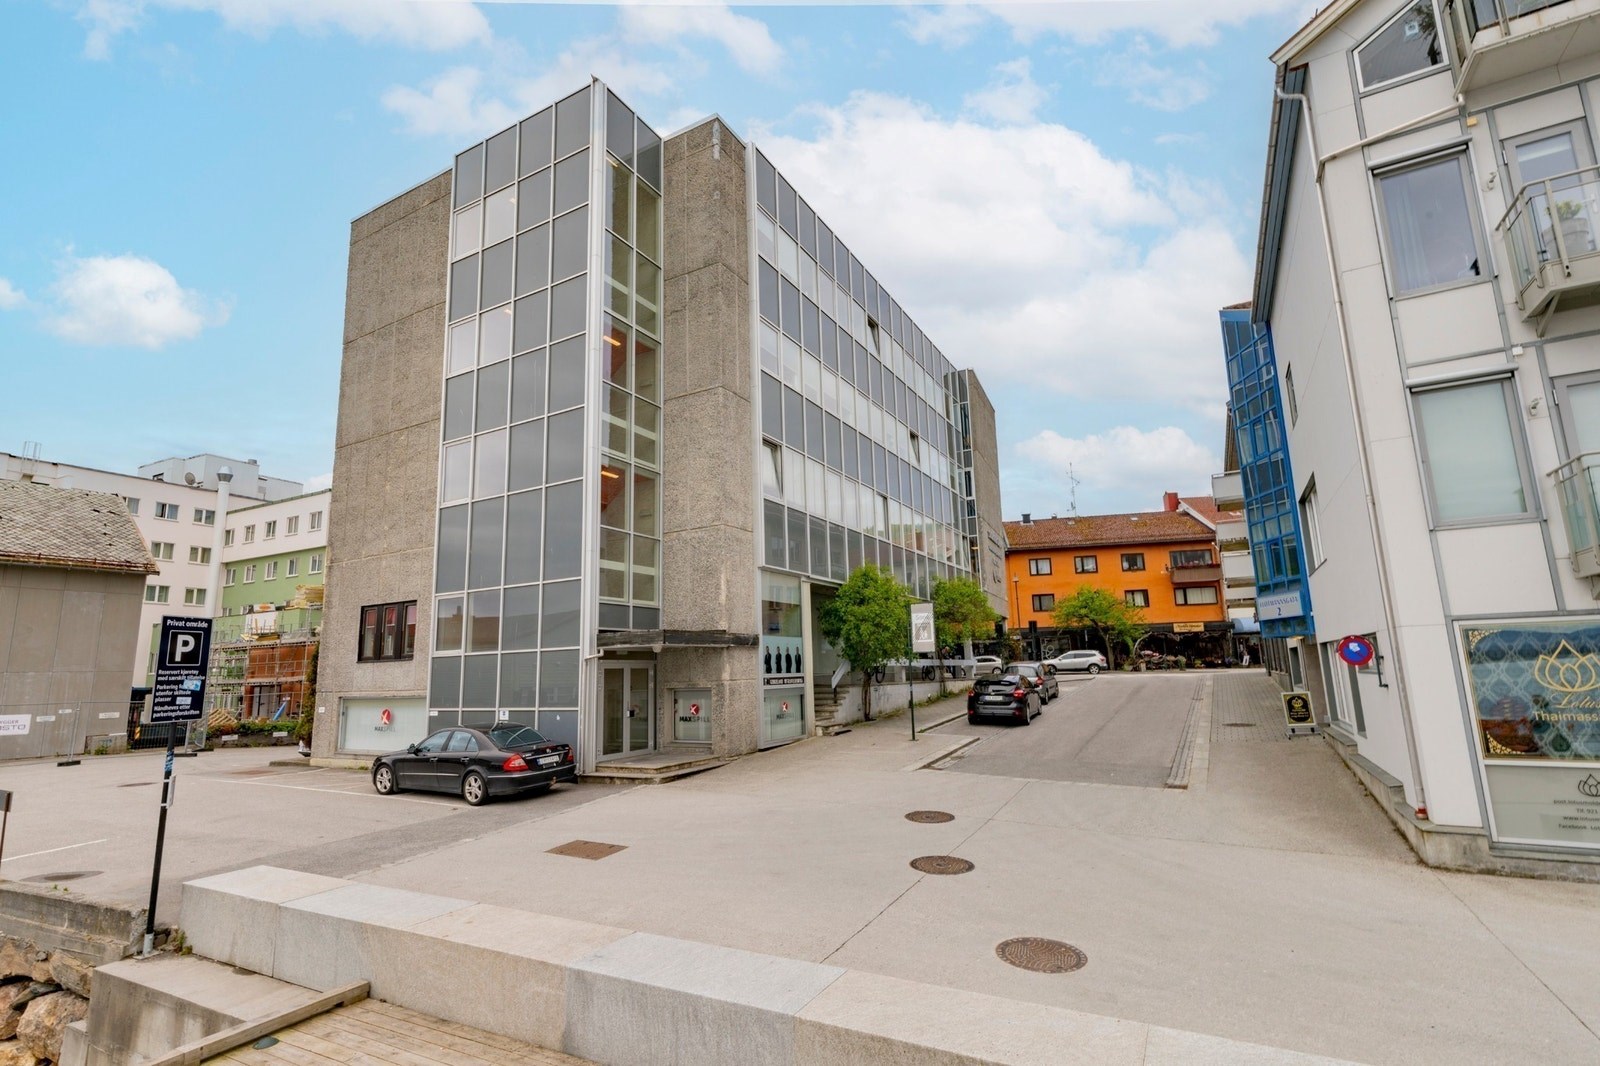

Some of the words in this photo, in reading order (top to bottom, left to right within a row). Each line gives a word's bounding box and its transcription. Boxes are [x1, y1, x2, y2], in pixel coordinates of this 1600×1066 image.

[1277, 607, 1282, 616] 2
[167, 619, 185, 627] Privat
[175, 634, 196, 662] P
[1532, 710, 1600, 721] Thaimass
